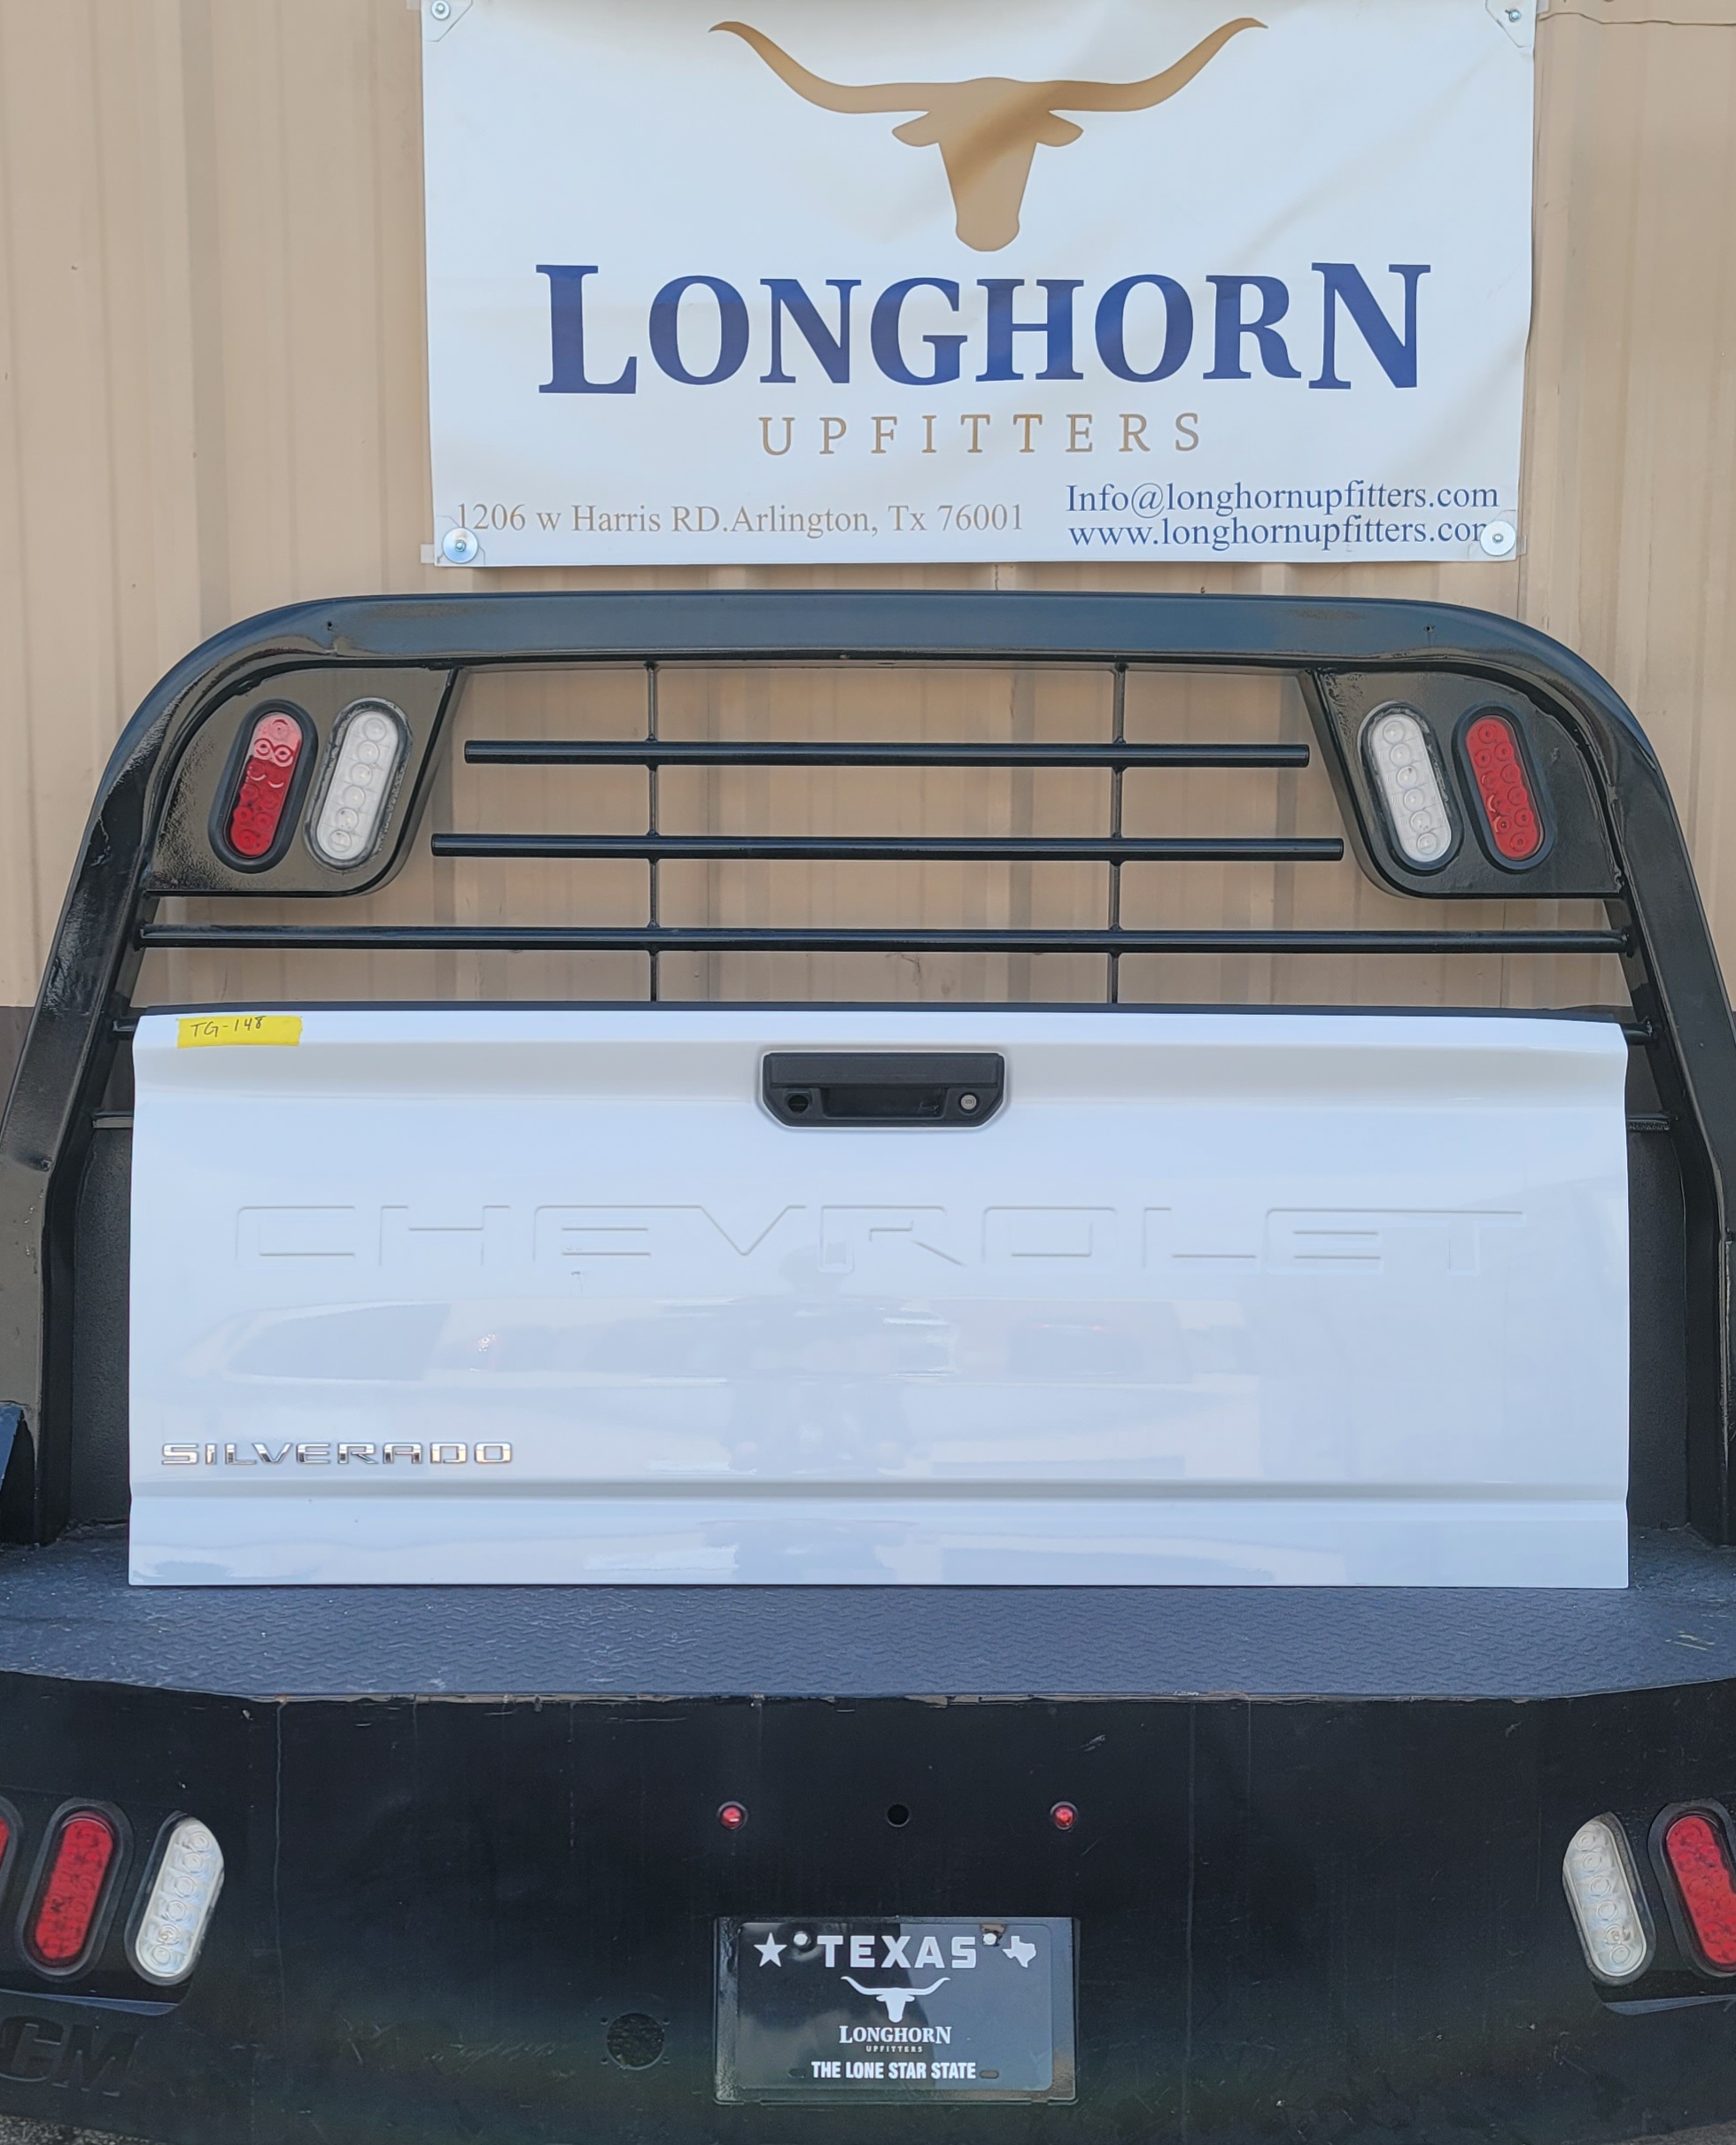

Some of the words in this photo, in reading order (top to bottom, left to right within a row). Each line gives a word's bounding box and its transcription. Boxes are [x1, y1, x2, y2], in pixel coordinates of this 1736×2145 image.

[535, 261, 1431, 394] LONGHORN
[758, 413, 1201, 456] UPFITTERS
[1066, 479, 1500, 519] Info@longhornupfitters.com
[457, 502, 527, 531] 1206
[536, 511, 562, 531] w
[571, 504, 662, 532] Harris
[887, 505, 927, 531] Tx
[936, 502, 1024, 532] 76001
[190, 1016, 267, 1038] TG-148
[234, 1204, 1529, 1277] CHEVROLET
[160, 1442, 515, 1466] SILVERADO
[816, 1934, 977, 1969] TEXAS
[838, 2025, 953, 2045] LONGHORN
[865, 2045, 924, 2054] UPFITTERS
[811, 2060, 841, 2079] THE
[845, 2061, 885, 2079] LONE
[888, 2061, 927, 2079] STAR
[930, 2061, 977, 2079] STATE
